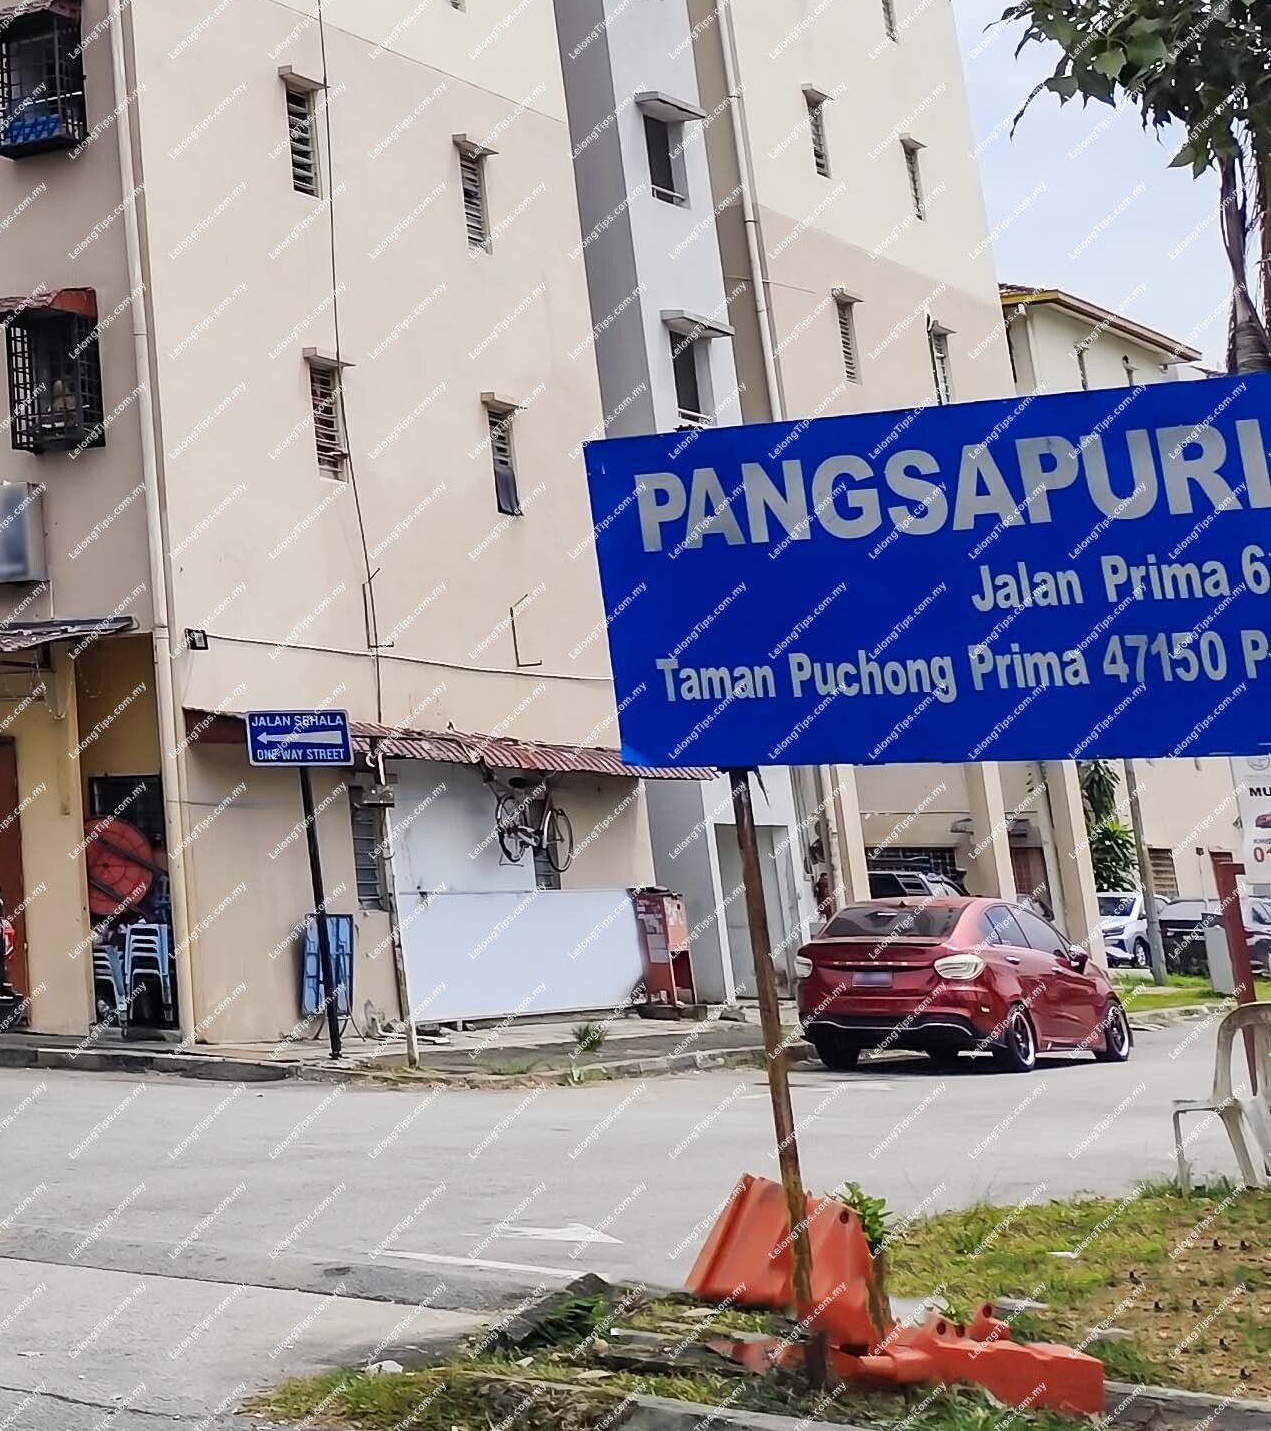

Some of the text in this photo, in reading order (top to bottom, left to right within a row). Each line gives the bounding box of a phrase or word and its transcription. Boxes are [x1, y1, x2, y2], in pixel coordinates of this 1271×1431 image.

[634, 419, 1271, 552] PANGSAPURI
[971, 561, 1084, 612] Jalan
[1100, 553, 1230, 603] Prima
[656, 658, 776, 702] Taman
[788, 649, 956, 703] Puchong
[967, 643, 1090, 691] Prima
[1102, 630, 1228, 684] 47150
[252, 715, 343, 726] JALAN SEHALA
[307, 749, 345, 760] STREET
